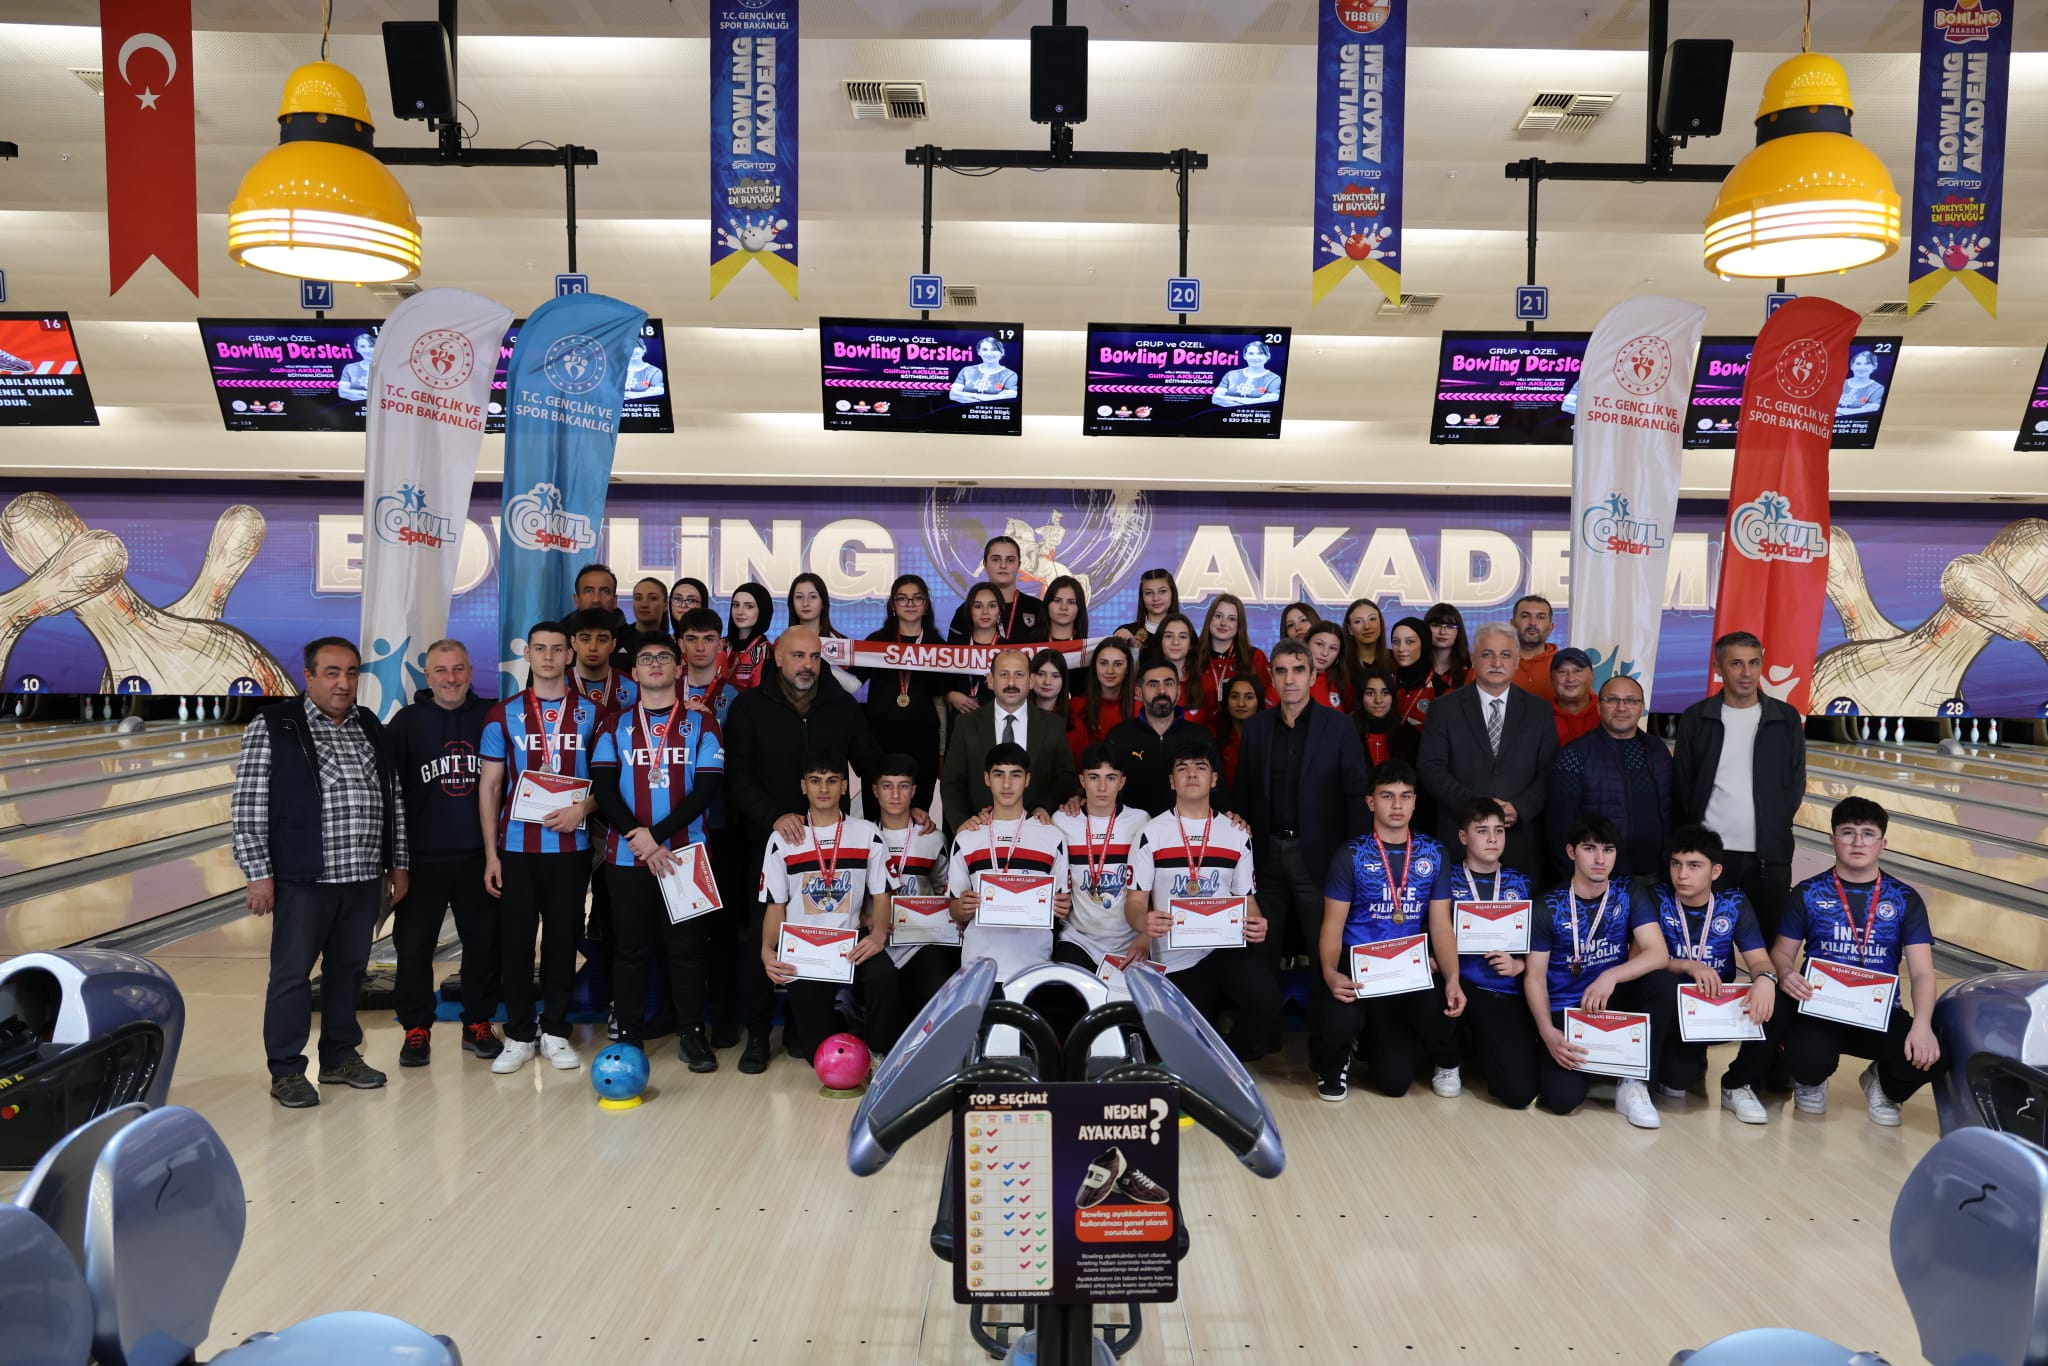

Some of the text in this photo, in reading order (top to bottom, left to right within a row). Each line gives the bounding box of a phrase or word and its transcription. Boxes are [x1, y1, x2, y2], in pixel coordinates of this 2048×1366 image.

[722, 12, 737, 20] T.C.
[738, 11, 774, 22] GENÇLİK
[741, 21, 789, 30] BAKANLIĞI
[306, 285, 326, 300] 17
[561, 284, 583, 295] 18
[915, 285, 937, 300] 19
[1173, 288, 1195, 303] 20
[1522, 296, 1542, 311] 21
[44, 319, 61, 329] 16
[290, 334, 315, 342] ÖZEL
[868, 335, 896, 343] GRUP
[911, 335, 938, 344] ÖZEL
[999, 330, 1015, 339] 19
[1264, 333, 1282, 344] 20
[1135, 340, 1163, 348] GRUP
[1179, 340, 1204, 348] ÖZEL
[1532, 347, 1558, 355] ÖZEL
[1874, 343, 1892, 353] 22
[216, 342, 353, 363] Bowling Dersleri
[833, 342, 973, 363] Bowling Dersleri
[1100, 347, 1239, 368] Bowling Dersleri
[1452, 355, 1584, 376] Bowling Dersle
[1708, 360, 1750, 376] Bowl
[27, 388, 74, 396] OLARAK
[386, 384, 481, 416] T.C. GENÇLİK VE
[521, 391, 542, 404] T.C.
[545, 395, 596, 417] GENÇLİK
[597, 407, 613, 419] VE
[1593, 396, 1678, 419] T.C. GENÇLİK VE
[380, 398, 482, 431] SPOR BAKANLIĞI
[1755, 395, 1830, 424] T.C. GENÇLİK VE
[516, 404, 614, 433] SPOR BAKANLIĞI
[1587, 411, 1680, 434] SPOR BAKANLIĞI
[1749, 410, 1830, 439] SPOR BAKANLIĞI
[384, 508, 456, 543] OKUL
[522, 510, 593, 543] OKUL
[1593, 517, 1664, 548] OKUL
[1747, 519, 1824, 552] OKUL
[23, 678, 40, 692] 10
[127, 680, 141, 692] 11
[238, 681, 253, 694] 12
[1834, 701, 1851, 714] 27
[1946, 702, 1964, 715] 28
[514, 734, 586, 751] VETEL
[622, 747, 692, 766] VETEL
[421, 755, 461, 784] GANT
[969, 1091, 1048, 1108] TOP SEÇİMİ
[1103, 1104, 1147, 1120] NEDEN
[1078, 1125, 1147, 1140] AYAKKABI
